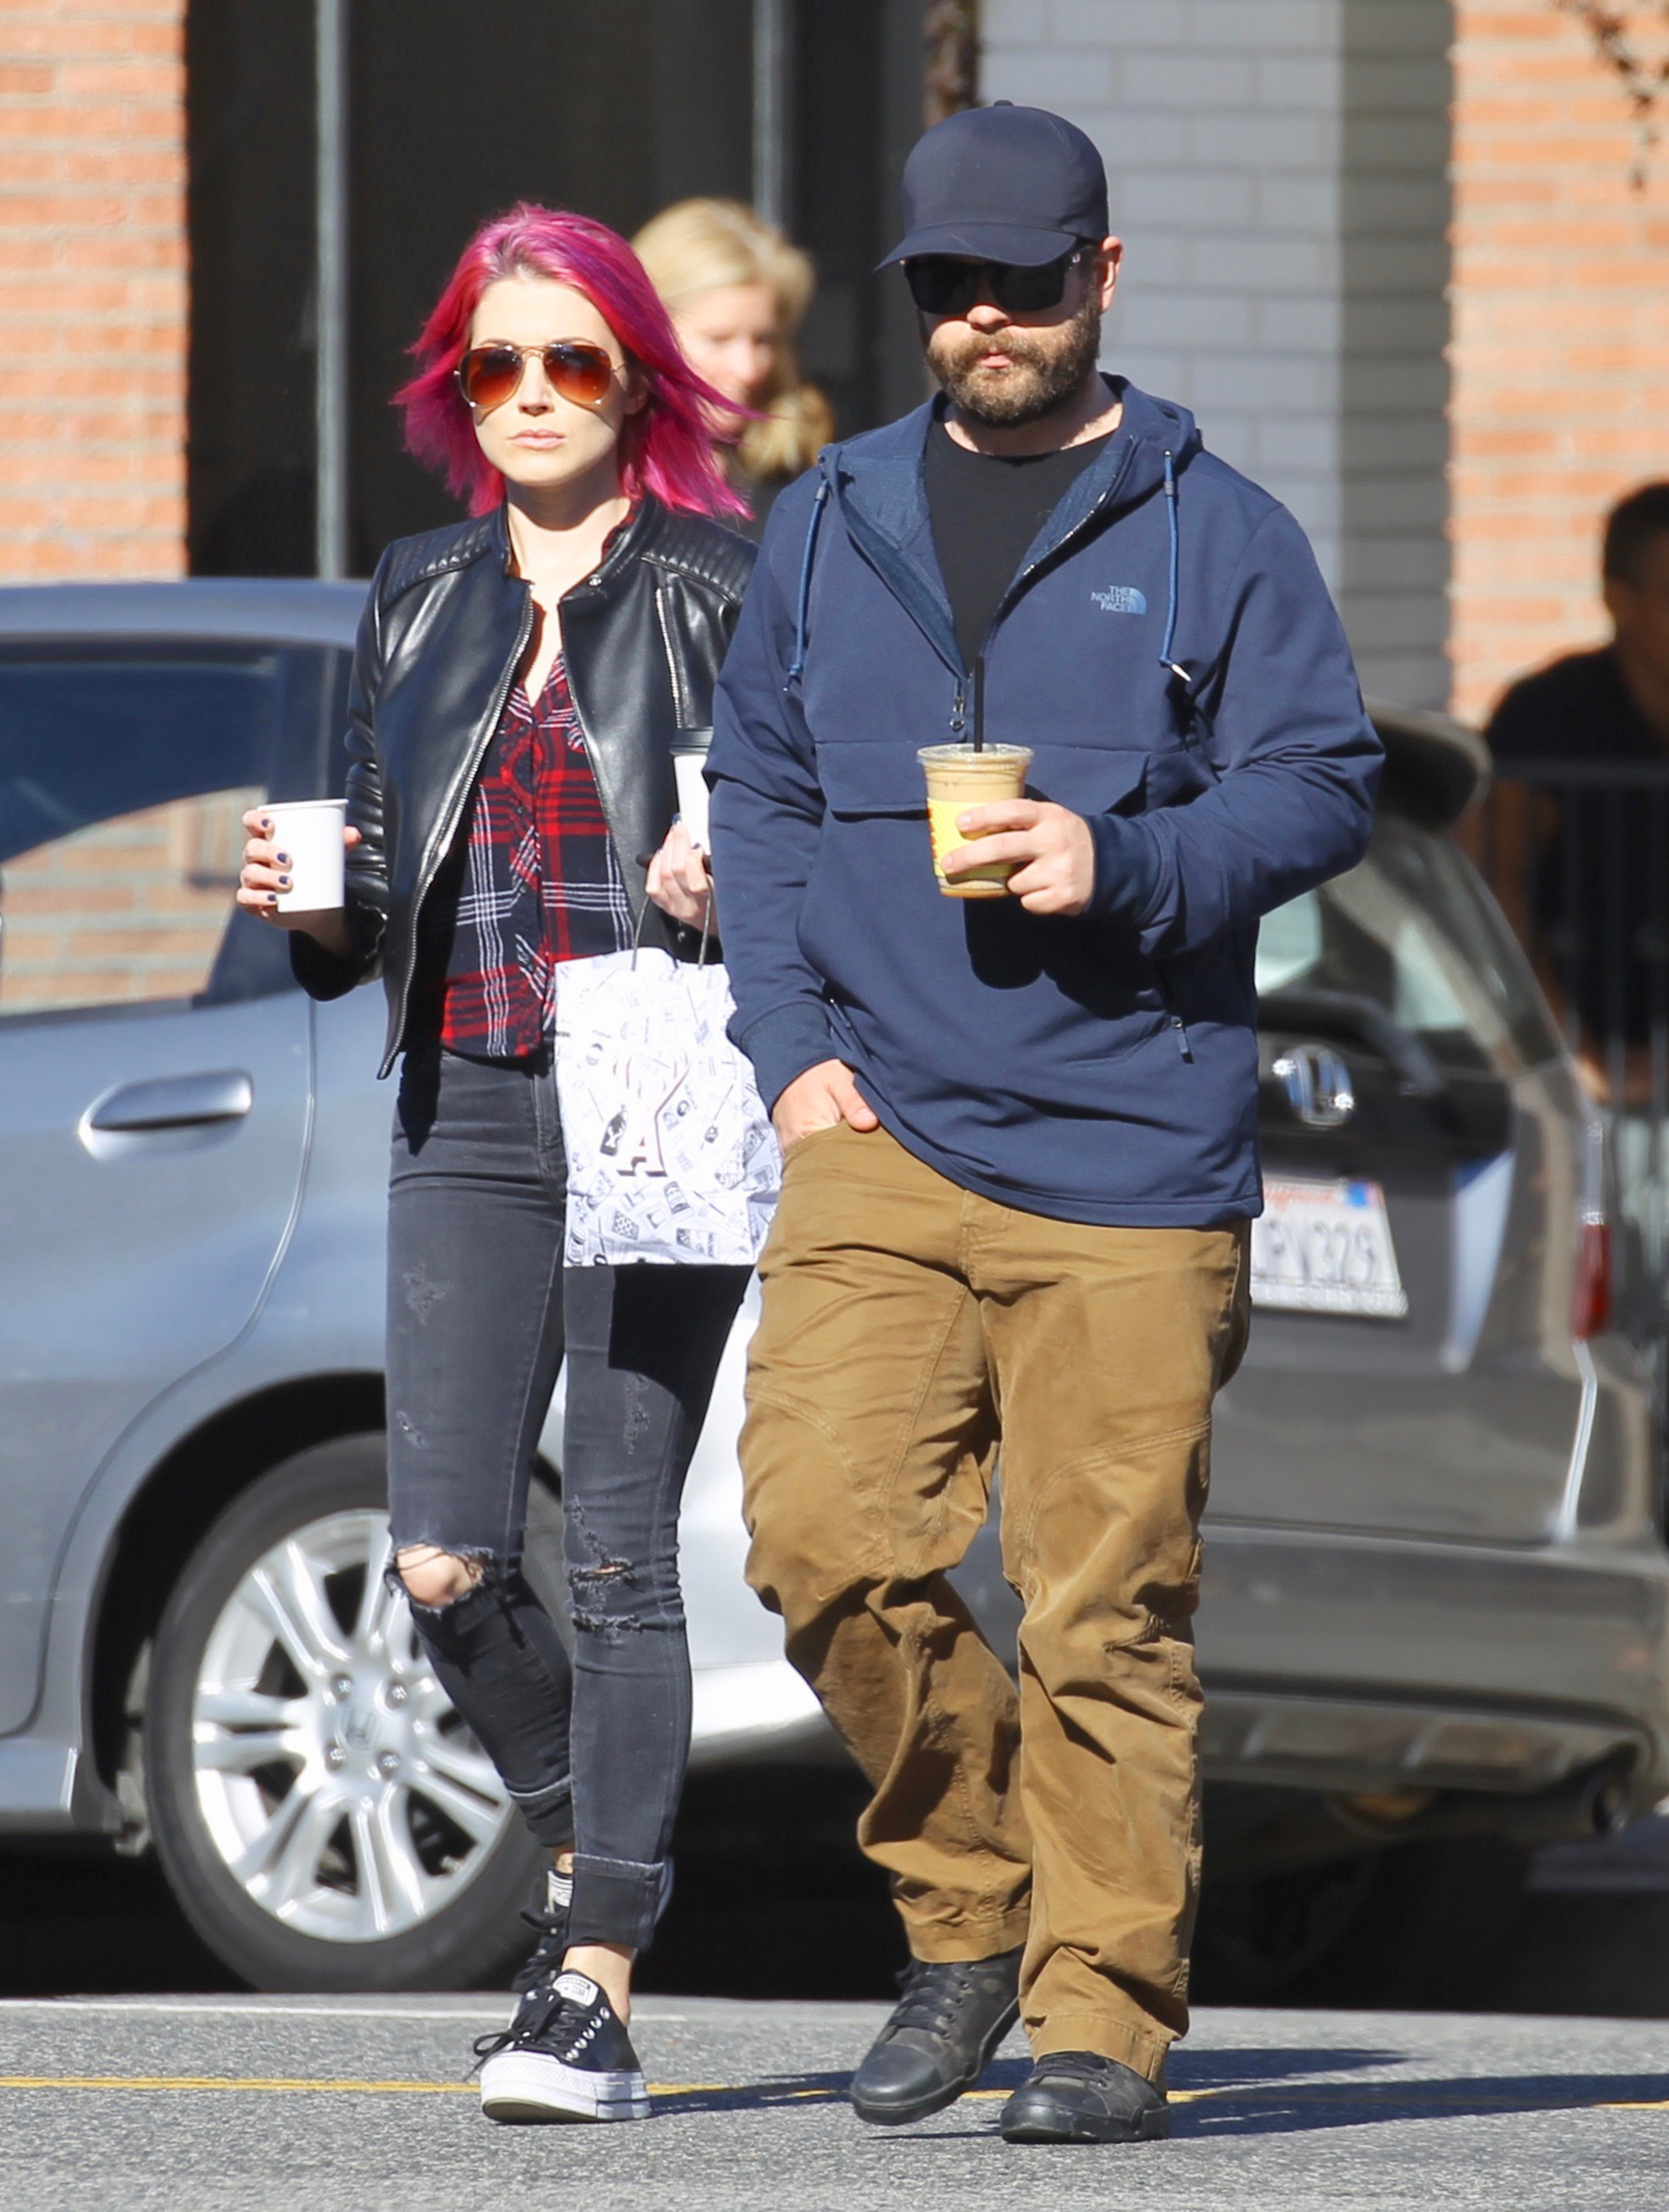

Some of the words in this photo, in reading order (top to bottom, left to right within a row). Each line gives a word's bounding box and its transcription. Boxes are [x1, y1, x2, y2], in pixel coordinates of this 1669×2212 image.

[1108, 585, 1128, 596] THE
[1091, 591, 1127, 603] NORTH
[1101, 601, 1127, 612] FACE
